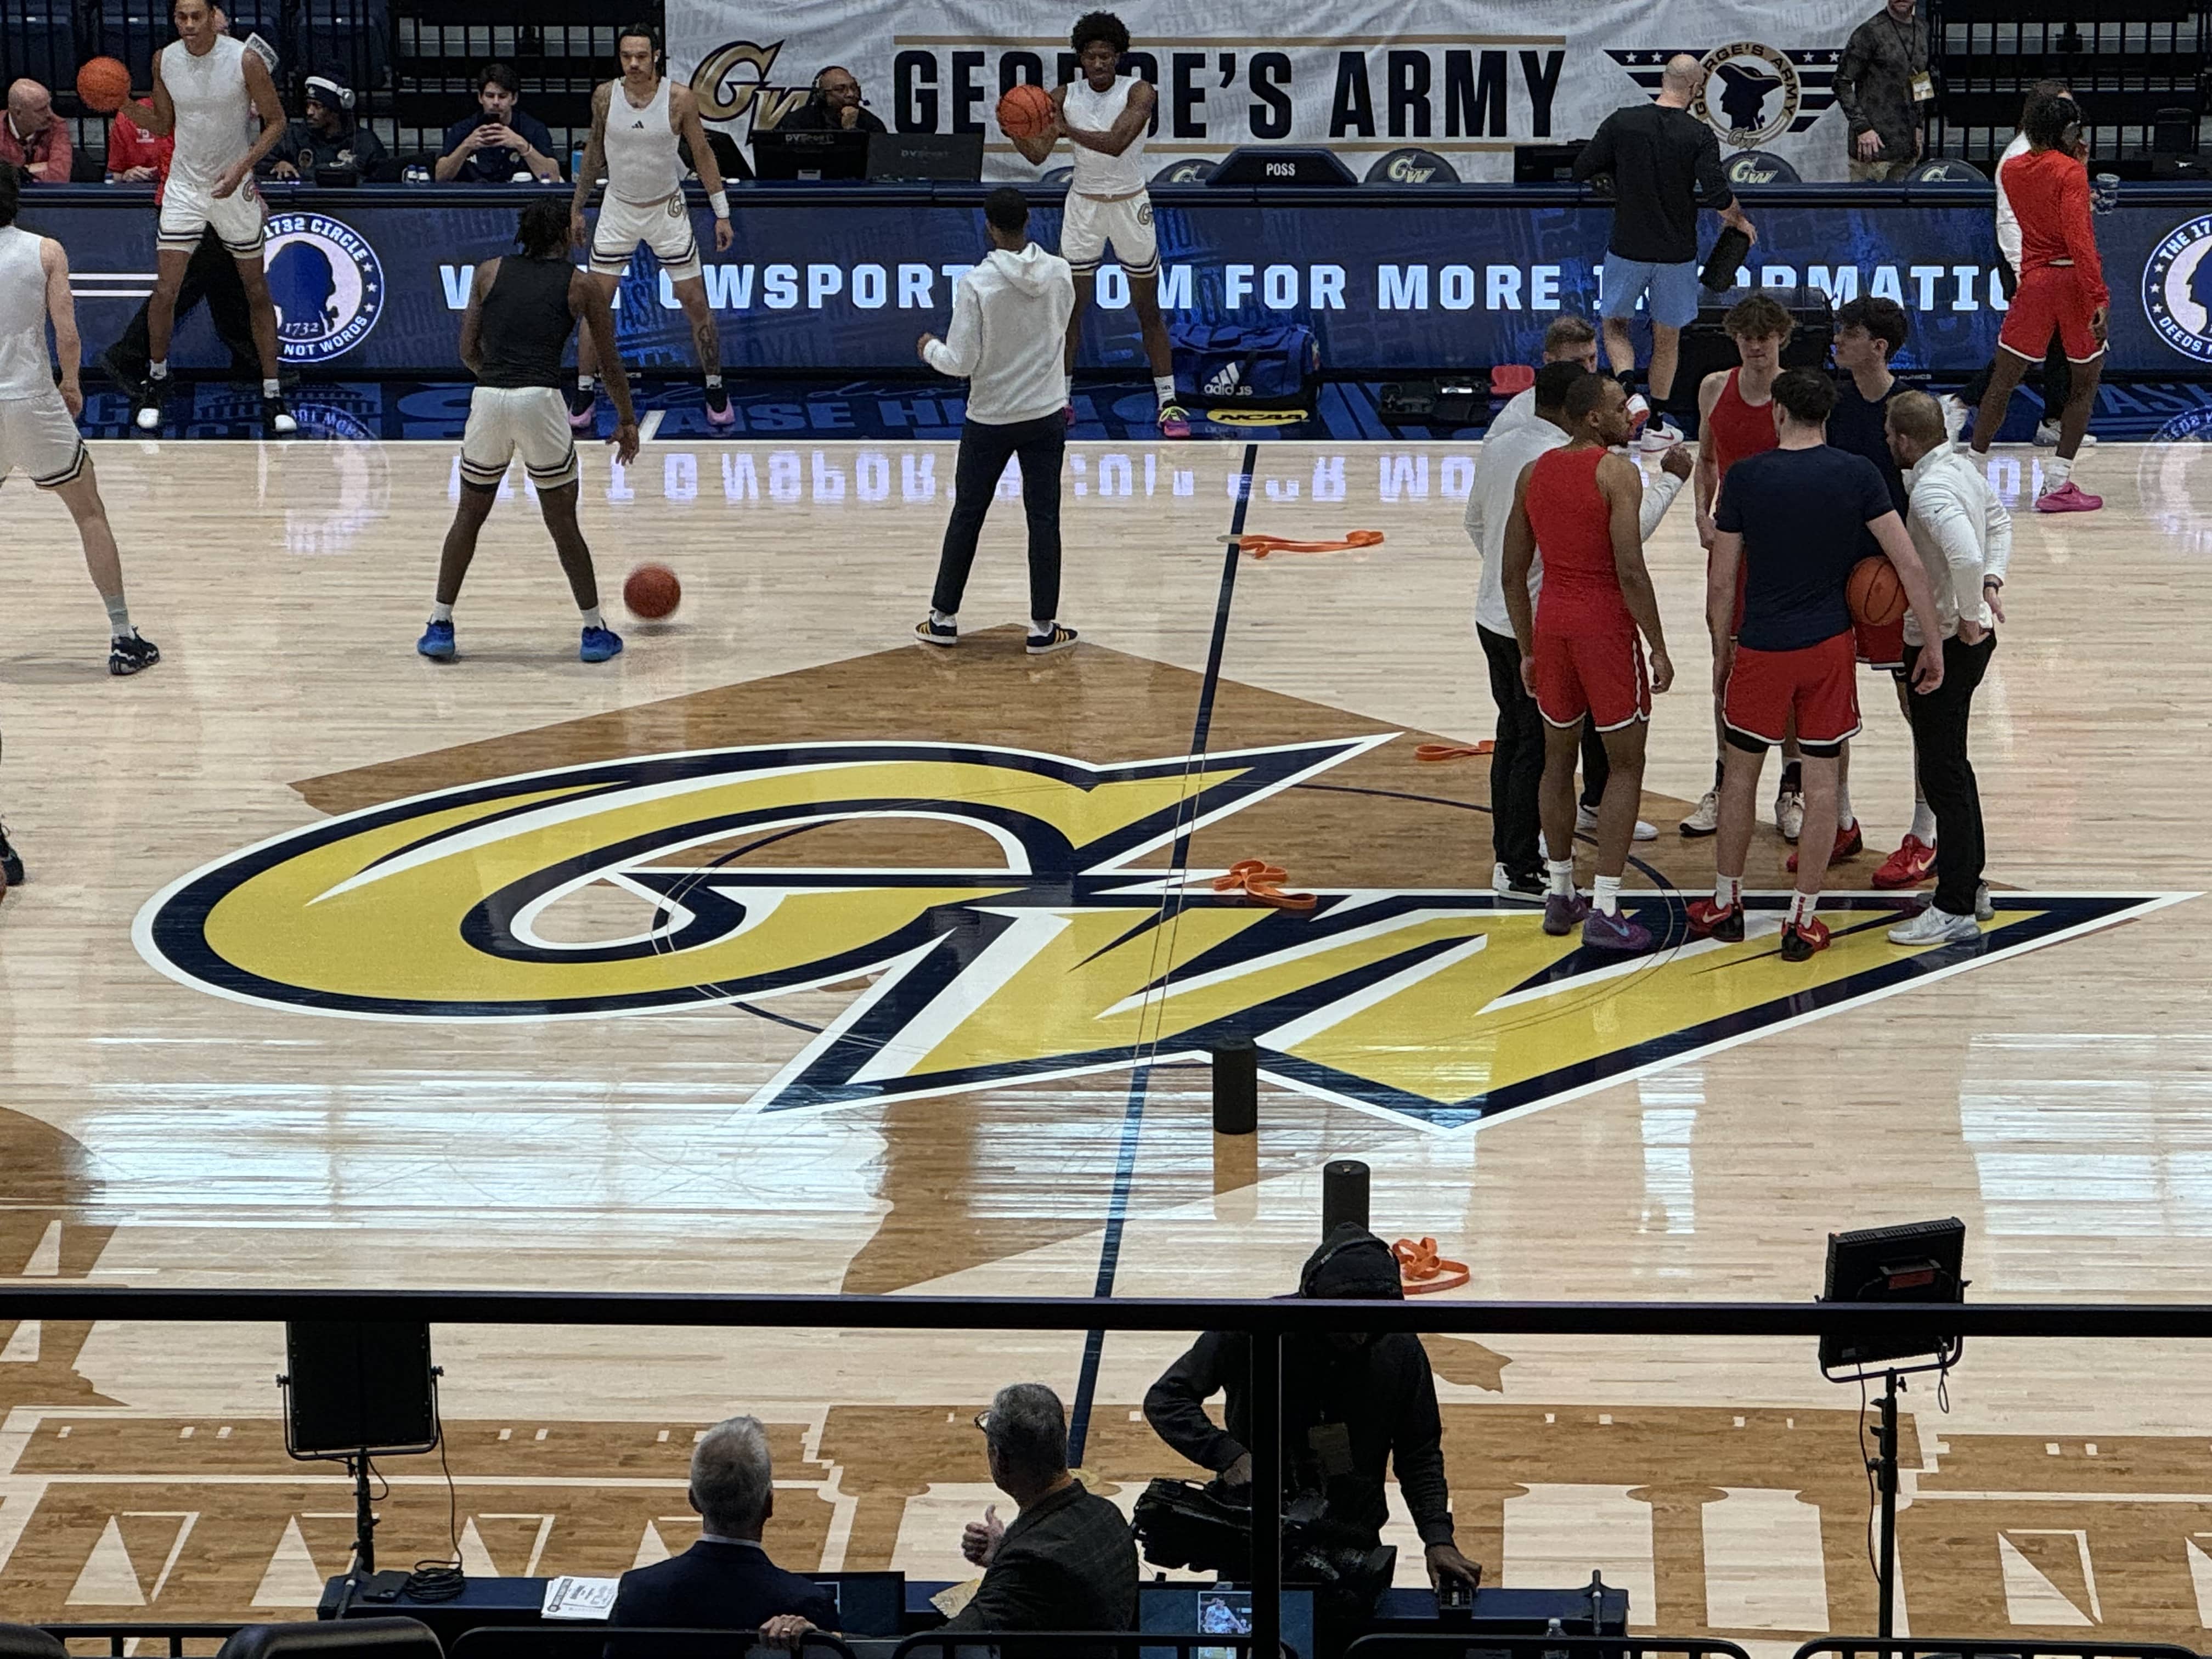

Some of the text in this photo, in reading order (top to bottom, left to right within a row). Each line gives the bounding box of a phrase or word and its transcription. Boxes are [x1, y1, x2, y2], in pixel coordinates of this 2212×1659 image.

[894, 50, 1291, 139] GEE'S
[1329, 50, 1566, 138] ARMY
[1770, 57, 1798, 116] ARMY
[1266, 162, 1296, 176] POSS
[1387, 154, 1437, 184] GW
[1729, 157, 1780, 184] GW
[263, 217, 305, 239] 1732
[310, 218, 369, 261] CIRCLE
[2159, 219, 2212, 261] THE 17
[1225, 264, 1346, 309] FOR
[1378, 264, 1561, 311] MORE
[283, 314, 368, 356] NOT WORDS
[285, 322, 319, 337] 1732
[2159, 316, 2203, 353] DEEDS
[1204, 383, 1253, 396] adids
